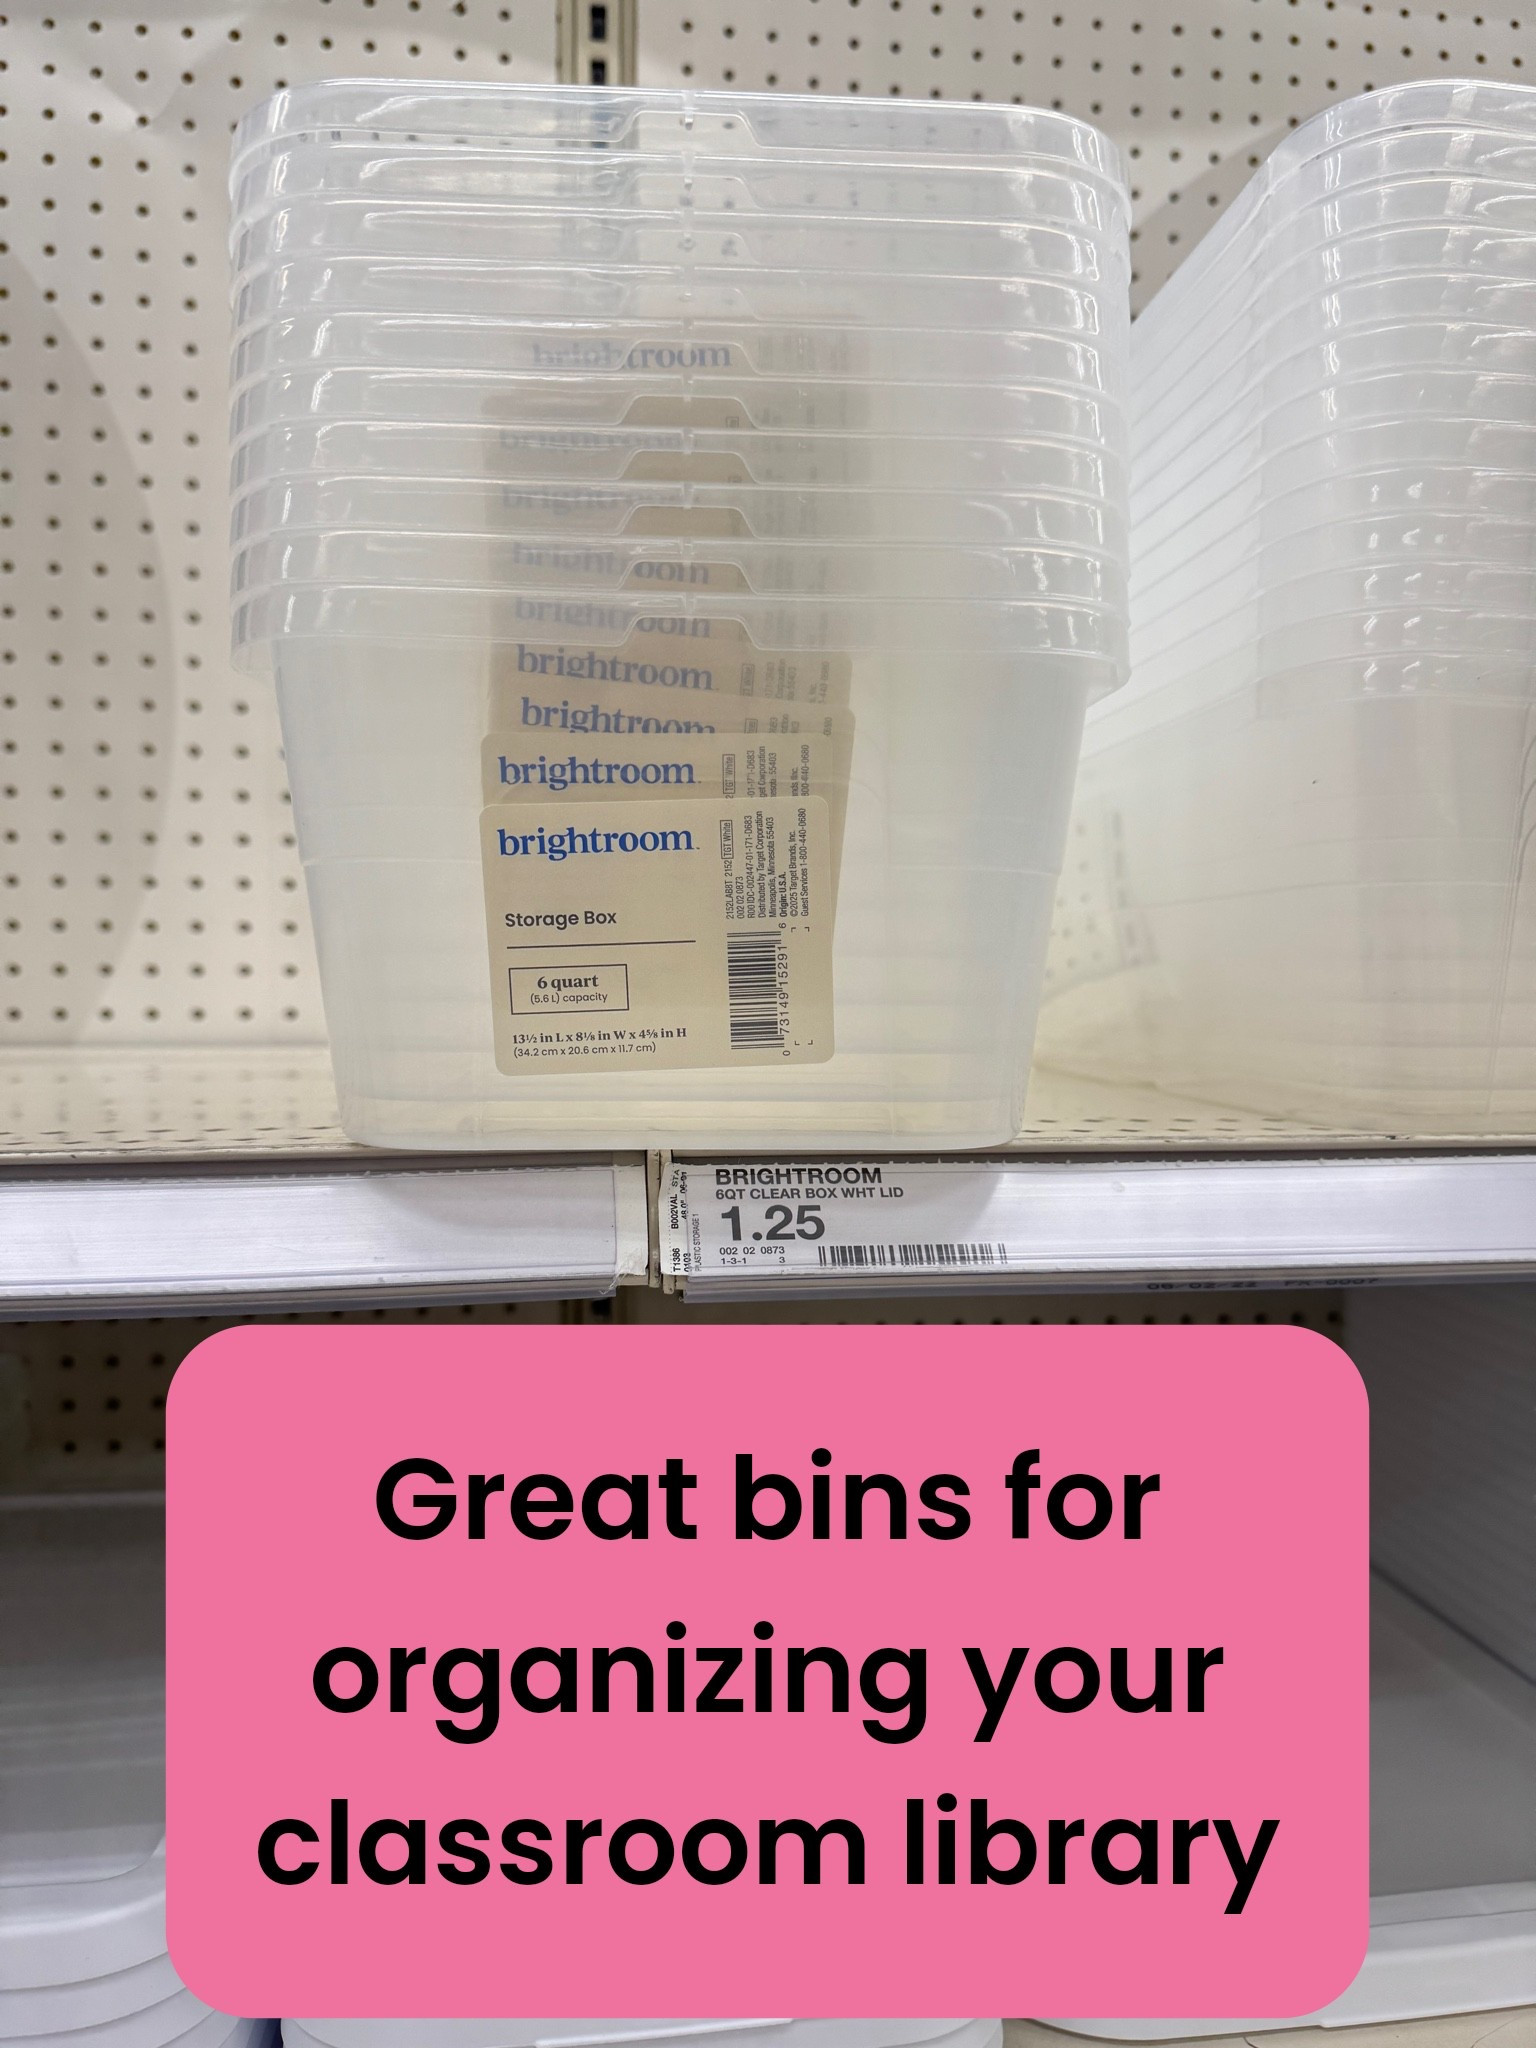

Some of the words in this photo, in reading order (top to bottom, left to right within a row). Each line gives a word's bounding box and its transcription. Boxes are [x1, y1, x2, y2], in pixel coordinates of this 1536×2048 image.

[517, 644, 715, 690] brightroom
[521, 697, 716, 733] brightroom
[498, 756, 696, 790] brightroom
[723, 823, 731, 841] White
[755, 811, 764, 849] Corporation
[766, 817, 774, 839] 55403
[798, 808, 807, 866] 1-800-440-0680
[497, 827, 692, 861] brightroom
[723, 844, 731, 856] TGT
[757, 851, 766, 871] Target
[767, 841, 775, 875] Minnesota
[789, 844, 797, 868] Brands,
[724, 860, 732, 876] 2152
[789, 871, 798, 889] Target
[800, 868, 808, 896] Services
[736, 896, 744, 904] 02
[758, 883, 766, 917] Distributed
[768, 877, 777, 917] Minneapolis,
[779, 894, 788, 917] Origin:
[790, 892, 798, 917] ©2025
[505, 913, 579, 930] Storage
[584, 911, 617, 924] Box
[736, 906, 744, 919] 002
[537, 976, 547, 989] 6
[551, 975, 599, 991] quart
[530, 995, 549, 1004] (5.6
[552, 993, 560, 1003] L)
[563, 992, 608, 1004] capacity
[540, 1033, 553, 1042] in
[556, 1033, 563, 1042] L
[598, 1031, 610, 1040] in
[613, 1030, 626, 1039] W
[661, 1028, 673, 1037] in
[677, 1028, 687, 1037] H
[514, 1047, 539, 1058] (34.2
[542, 1048, 558, 1056] cm
[568, 1046, 589, 1054] 20.6
[592, 1046, 608, 1054] cm
[619, 1044, 633, 1053] 11.7
[636, 1042, 656, 1053] cm)
[716, 1168, 882, 1185] BRIGHTROOM
[716, 1189, 745, 1199] 6QT
[750, 1189, 800, 1199] CLEAR
[806, 1188, 837, 1198] BOX
[841, 1188, 875, 1198] WHT
[880, 1187, 904, 1197] LID
[670, 1194, 678, 1229] B002VAL
[721, 1205, 825, 1240] 1.25
[720, 1247, 737, 1255] 002
[761, 1246, 785, 1254] 0873
